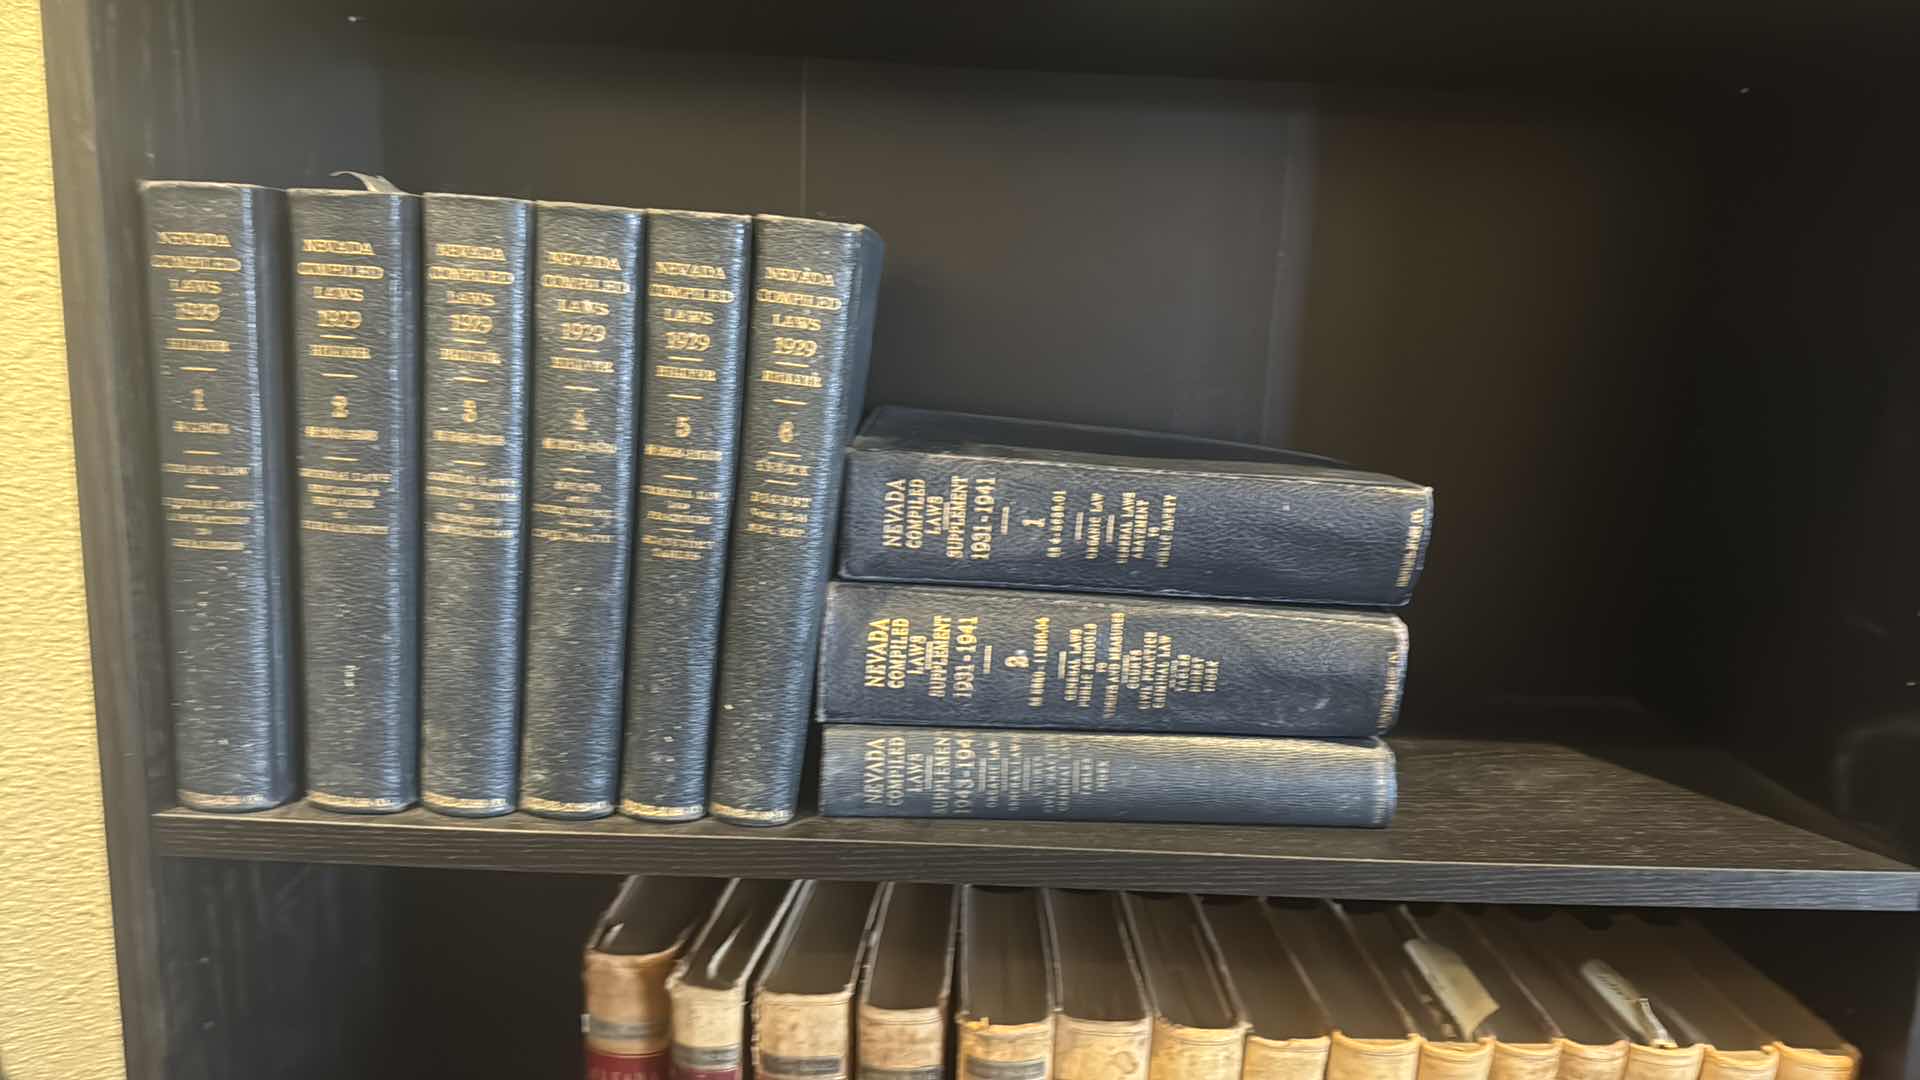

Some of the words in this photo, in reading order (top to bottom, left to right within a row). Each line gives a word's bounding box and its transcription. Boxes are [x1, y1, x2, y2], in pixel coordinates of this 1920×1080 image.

[655, 261, 727, 280] NEVADA
[765, 266, 835, 287] NEVADA
[313, 286, 364, 302] LAWS
[447, 290, 496, 306] LAWS
[558, 299, 609, 315] LAWS
[663, 308, 715, 325] LAWS
[559, 322, 607, 342] 1929
[772, 313, 822, 331] LAWS
[664, 331, 711, 351] 1929
[772, 336, 818, 358] 1929
[192, 388, 208, 411] 1
[331, 395, 348, 418] 2
[463, 400, 477, 423] 3
[674, 416, 691, 438] 5
[777, 421, 796, 443] 6
[881, 478, 906, 548] NEVADA
[904, 479, 926, 550] COMPILED
[1090, 492, 1105, 512] LAW
[1121, 492, 1136, 517] LAWS
[1161, 494, 1177, 531] SAFETY
[924, 495, 944, 536] LAWS
[945, 475, 969, 559] SUPPLEMENT
[969, 477, 996, 560] 1931-1941
[1021, 517, 1046, 528] 1
[1085, 516, 1102, 559] ORGANIC
[1068, 629, 1082, 654] LAWS
[1082, 623, 1097, 670] SCHOOLS
[1107, 612, 1125, 660] MEASURES
[1157, 635, 1173, 657] LAW
[864, 618, 890, 688] NEVADA
[887, 618, 910, 689] COMPILED
[906, 635, 927, 675] LAWS
[928, 615, 951, 698] SUPPLEMENT
[953, 616, 978, 699] 1931-1941
[1141, 631, 1157, 681] PRACTICE
[1063, 659, 1080, 701] GENERAL
[1106, 663, 1121, 683] AND
[1152, 661, 1170, 708] CRIMINAL
[1079, 674, 1093, 707] PUBLIC
[987, 740, 1000, 761] LAW
[864, 738, 885, 804] NEVADA
[886, 736, 905, 806] COMPILED
[906, 753, 924, 792] LAWS
